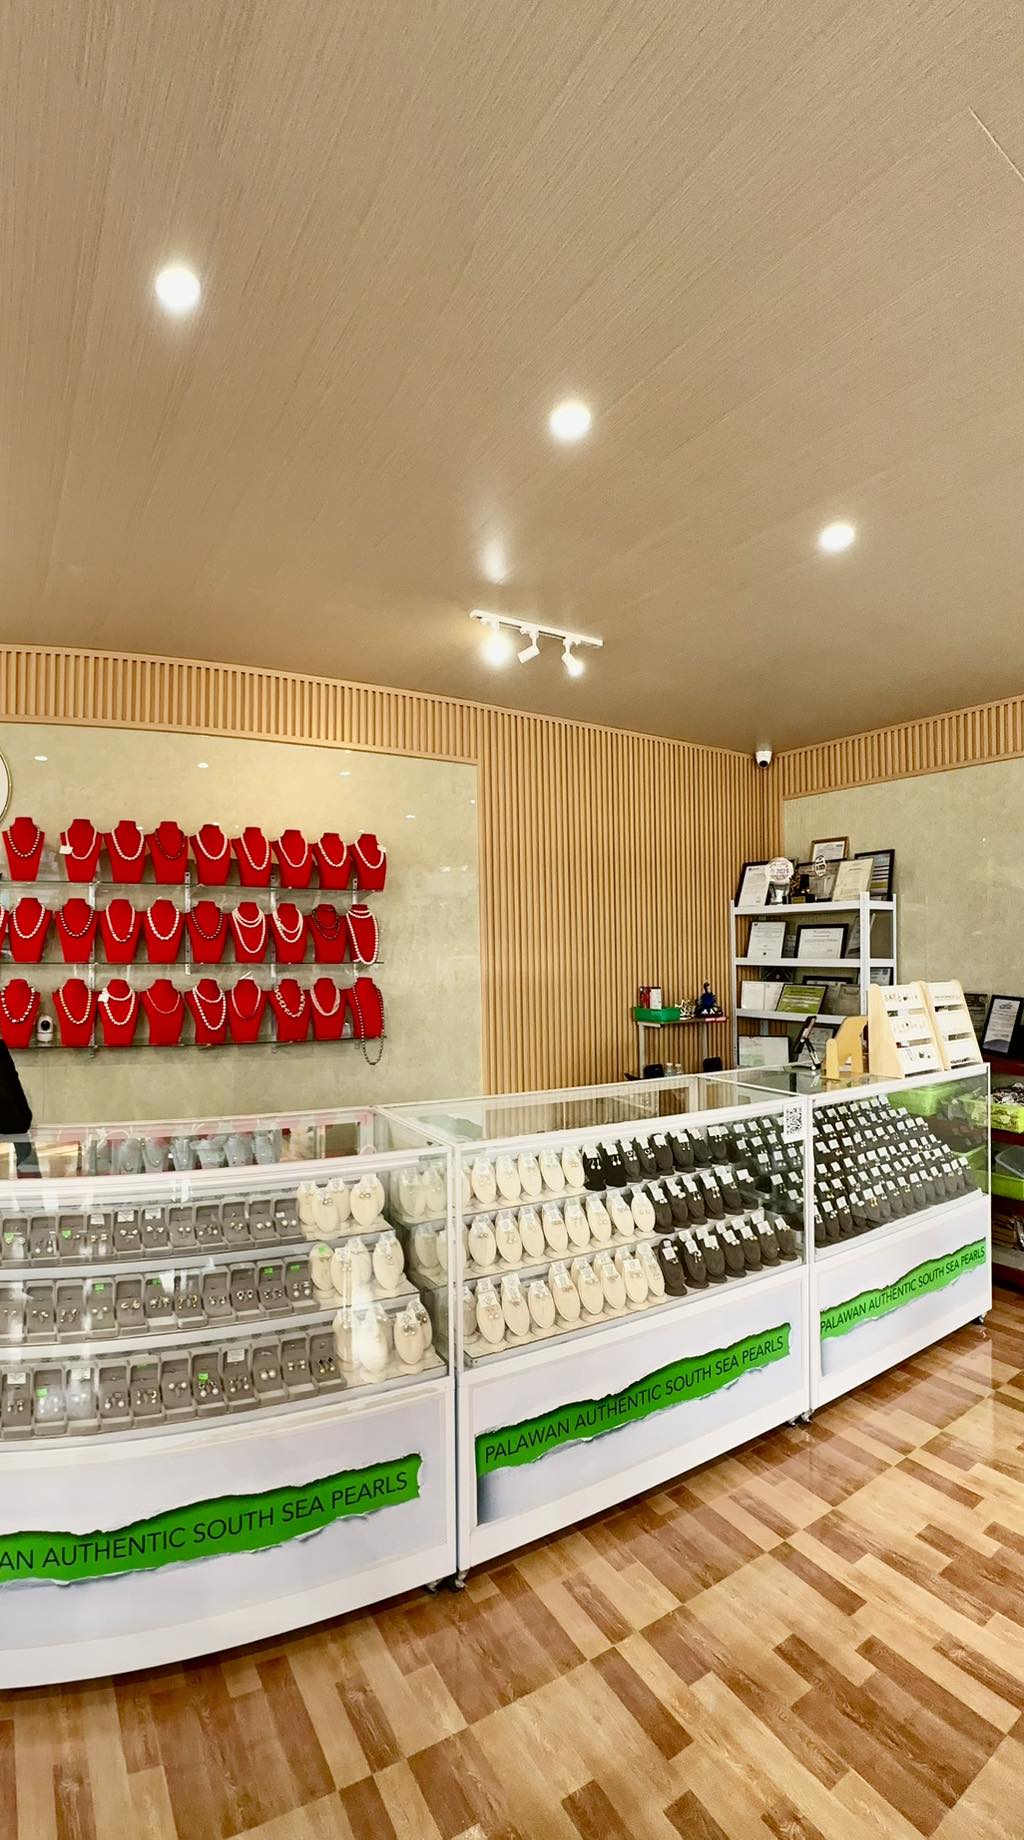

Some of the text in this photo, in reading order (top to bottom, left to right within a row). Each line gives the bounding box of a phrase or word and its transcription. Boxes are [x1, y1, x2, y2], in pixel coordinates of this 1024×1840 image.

[820, 1247, 985, 1334] PALAWAN AUTHENTIC SOUTH SEA PEARLS
[486, 1336, 784, 1463] PALAWAN AUTHENTIC SOUTH SEA PEARLS
[43, 1527, 186, 1566] AUTHENTIC
[193, 1507, 274, 1542] SOUTH
[281, 1498, 324, 1522] SEA
[331, 1472, 408, 1509] PEARLS
